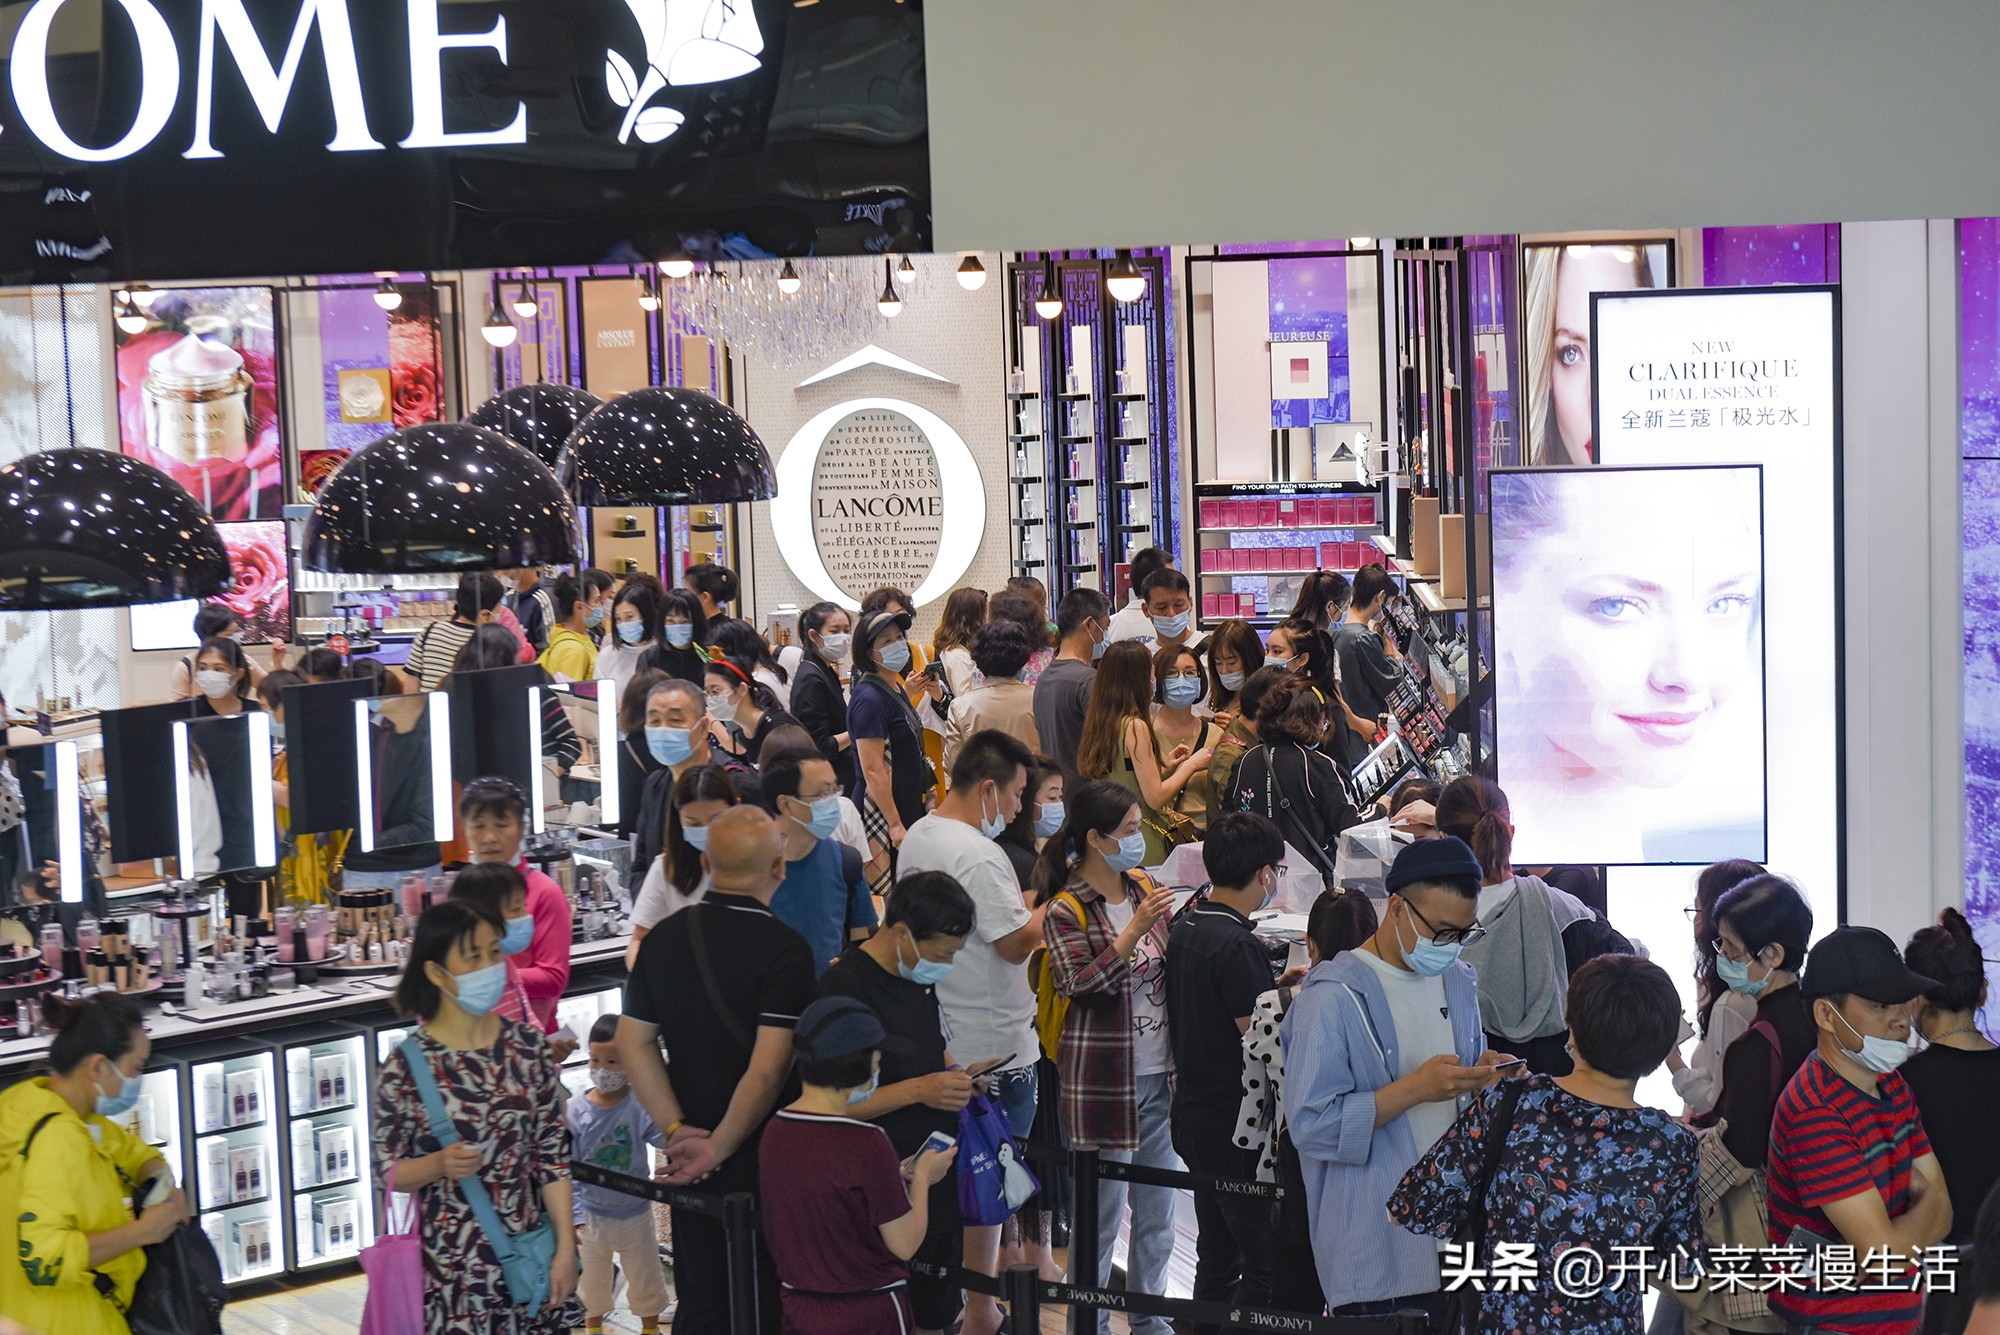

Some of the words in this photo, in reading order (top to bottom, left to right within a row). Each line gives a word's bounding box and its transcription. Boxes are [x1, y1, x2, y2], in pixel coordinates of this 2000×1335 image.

[0, 0, 528, 163] OME
[1692, 341, 1734, 354] NEW
[1629, 359, 1798, 382] CLARIFIQUE
[1650, 388, 1698, 401] DUAL
[1703, 385, 1779, 400] ESSENCE
[1621, 407, 1812, 429] 全新兰蔻「极光水」
[869, 456, 933, 467] BEAUTÉ
[880, 479, 938, 489] MAISON
[818, 493, 942, 518] LANCÔME
[840, 520, 901, 532] LIBERTÉ
